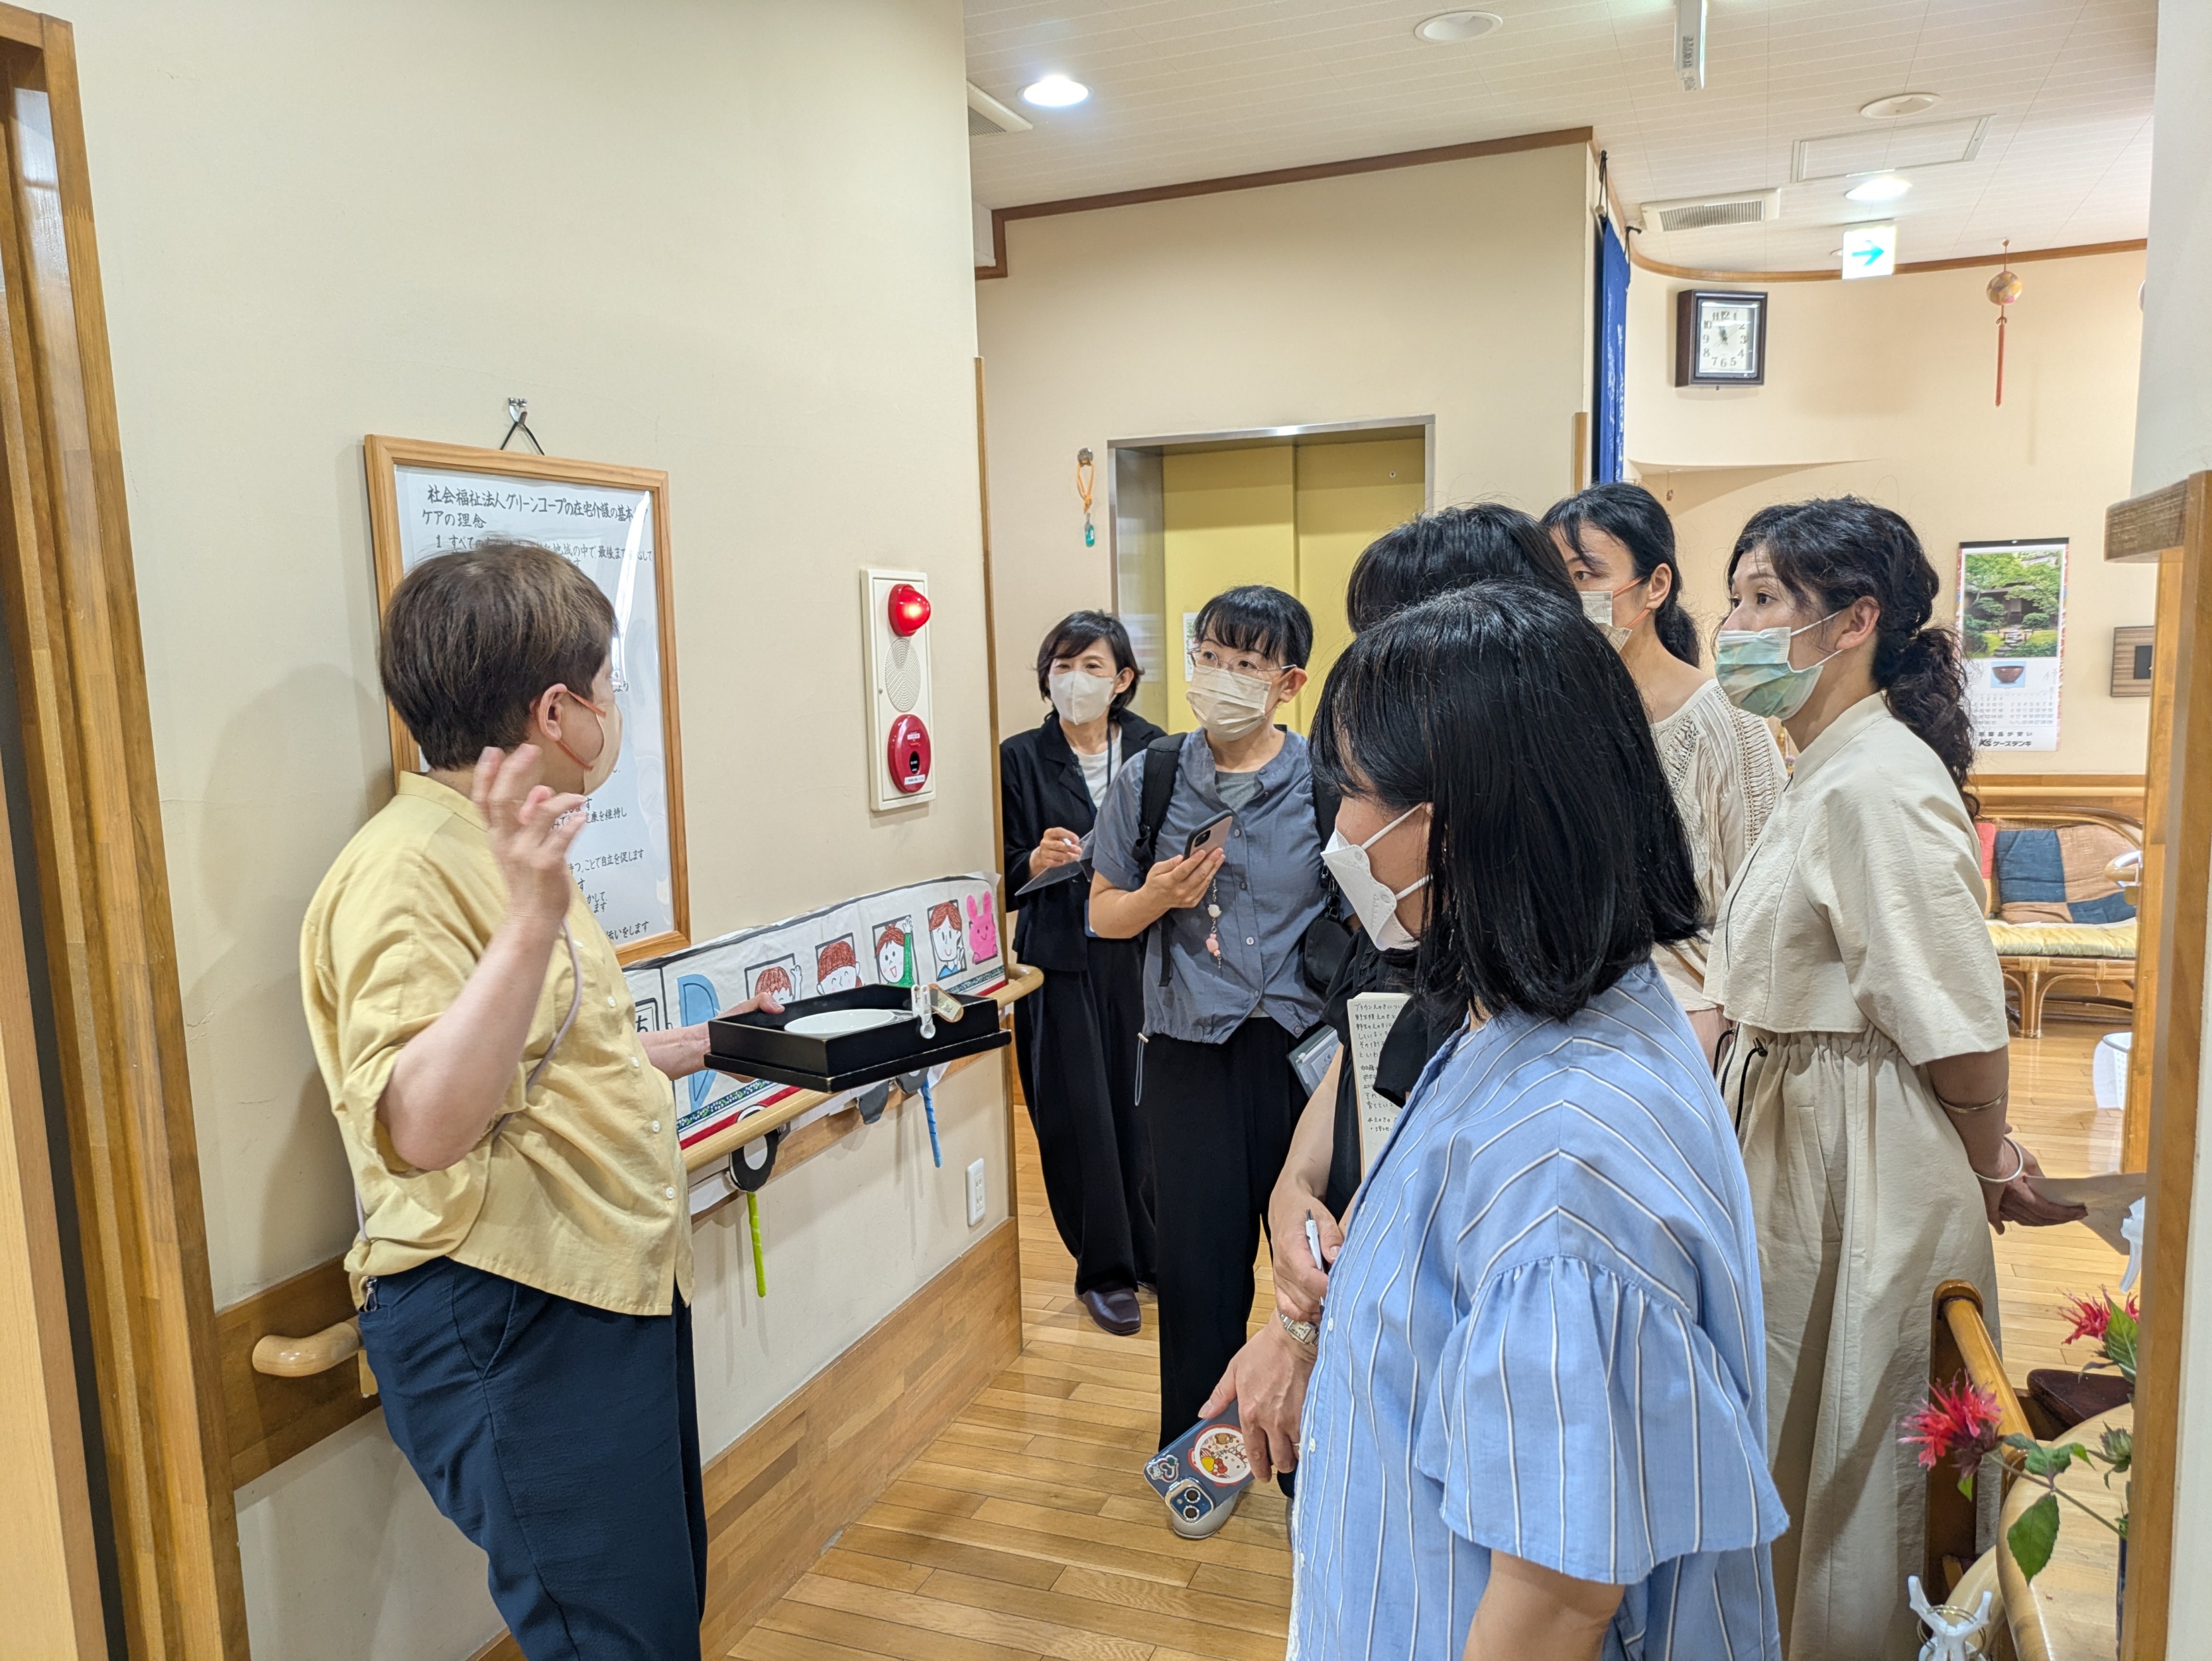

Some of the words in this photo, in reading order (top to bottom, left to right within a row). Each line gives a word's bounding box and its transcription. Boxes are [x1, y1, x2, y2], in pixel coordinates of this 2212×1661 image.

[1713, 312, 1719, 321] 11
[1721, 311, 1730, 320] 12
[1704, 320, 1712, 329] 10
[1703, 334, 1709, 344] 9
[1740, 334, 1747, 344] 3
[1703, 348, 1710, 357] 8
[1737, 348, 1744, 358] 4
[1711, 356, 1718, 366] 7
[1720, 358, 1727, 367] 6
[1730, 357, 1736, 366] 5
[427, 484, 648, 522] 社会福祉法人グリーンコープの在宅介護の基本
[422, 509, 487, 528] ケアの理念
[593, 902, 607, 913] ます
